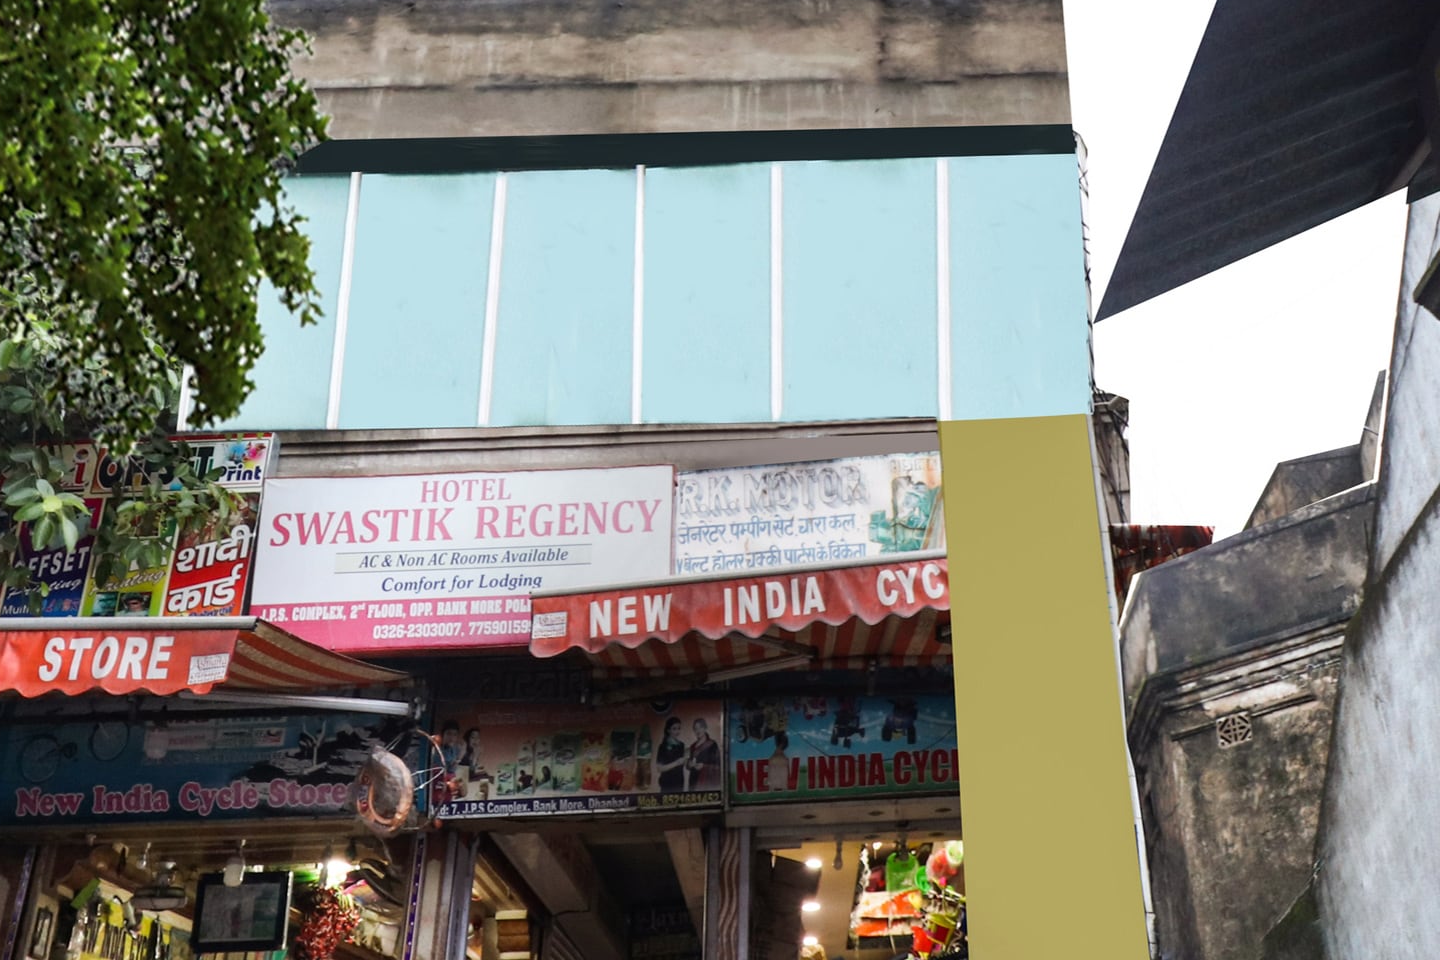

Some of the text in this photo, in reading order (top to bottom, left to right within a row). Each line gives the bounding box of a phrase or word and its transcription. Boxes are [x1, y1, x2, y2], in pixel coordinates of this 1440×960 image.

[420, 478, 512, 503] HOTEL
[744, 466, 872, 511] MOTOR
[269, 499, 662, 547] SWASTIK REGENCY
[14, 546, 90, 578] FFSET
[175, 524, 255, 573] शादी
[359, 547, 569, 568] AC & Non AC Rooms Available
[167, 563, 243, 613] कार्ड
[381, 572, 542, 594] Comfort for Lodging
[292, 605, 347, 622] COMPLEX,
[350, 602, 366, 619] 2nd
[367, 602, 407, 619] FLOOR,
[410, 601, 434, 617] OPP.
[437, 600, 467, 616] BANK
[470, 599, 502, 615] MORE
[589, 593, 672, 638] NEW
[723, 576, 826, 627] INDIA
[39, 636, 175, 681] STORE
[807, 753, 886, 789] INDIA
[15, 784, 85, 817] New
[90, 783, 169, 813] India
[177, 779, 259, 816] Cycle
[533, 799, 557, 812] Bank
[588, 796, 630, 809] Dhanbad
